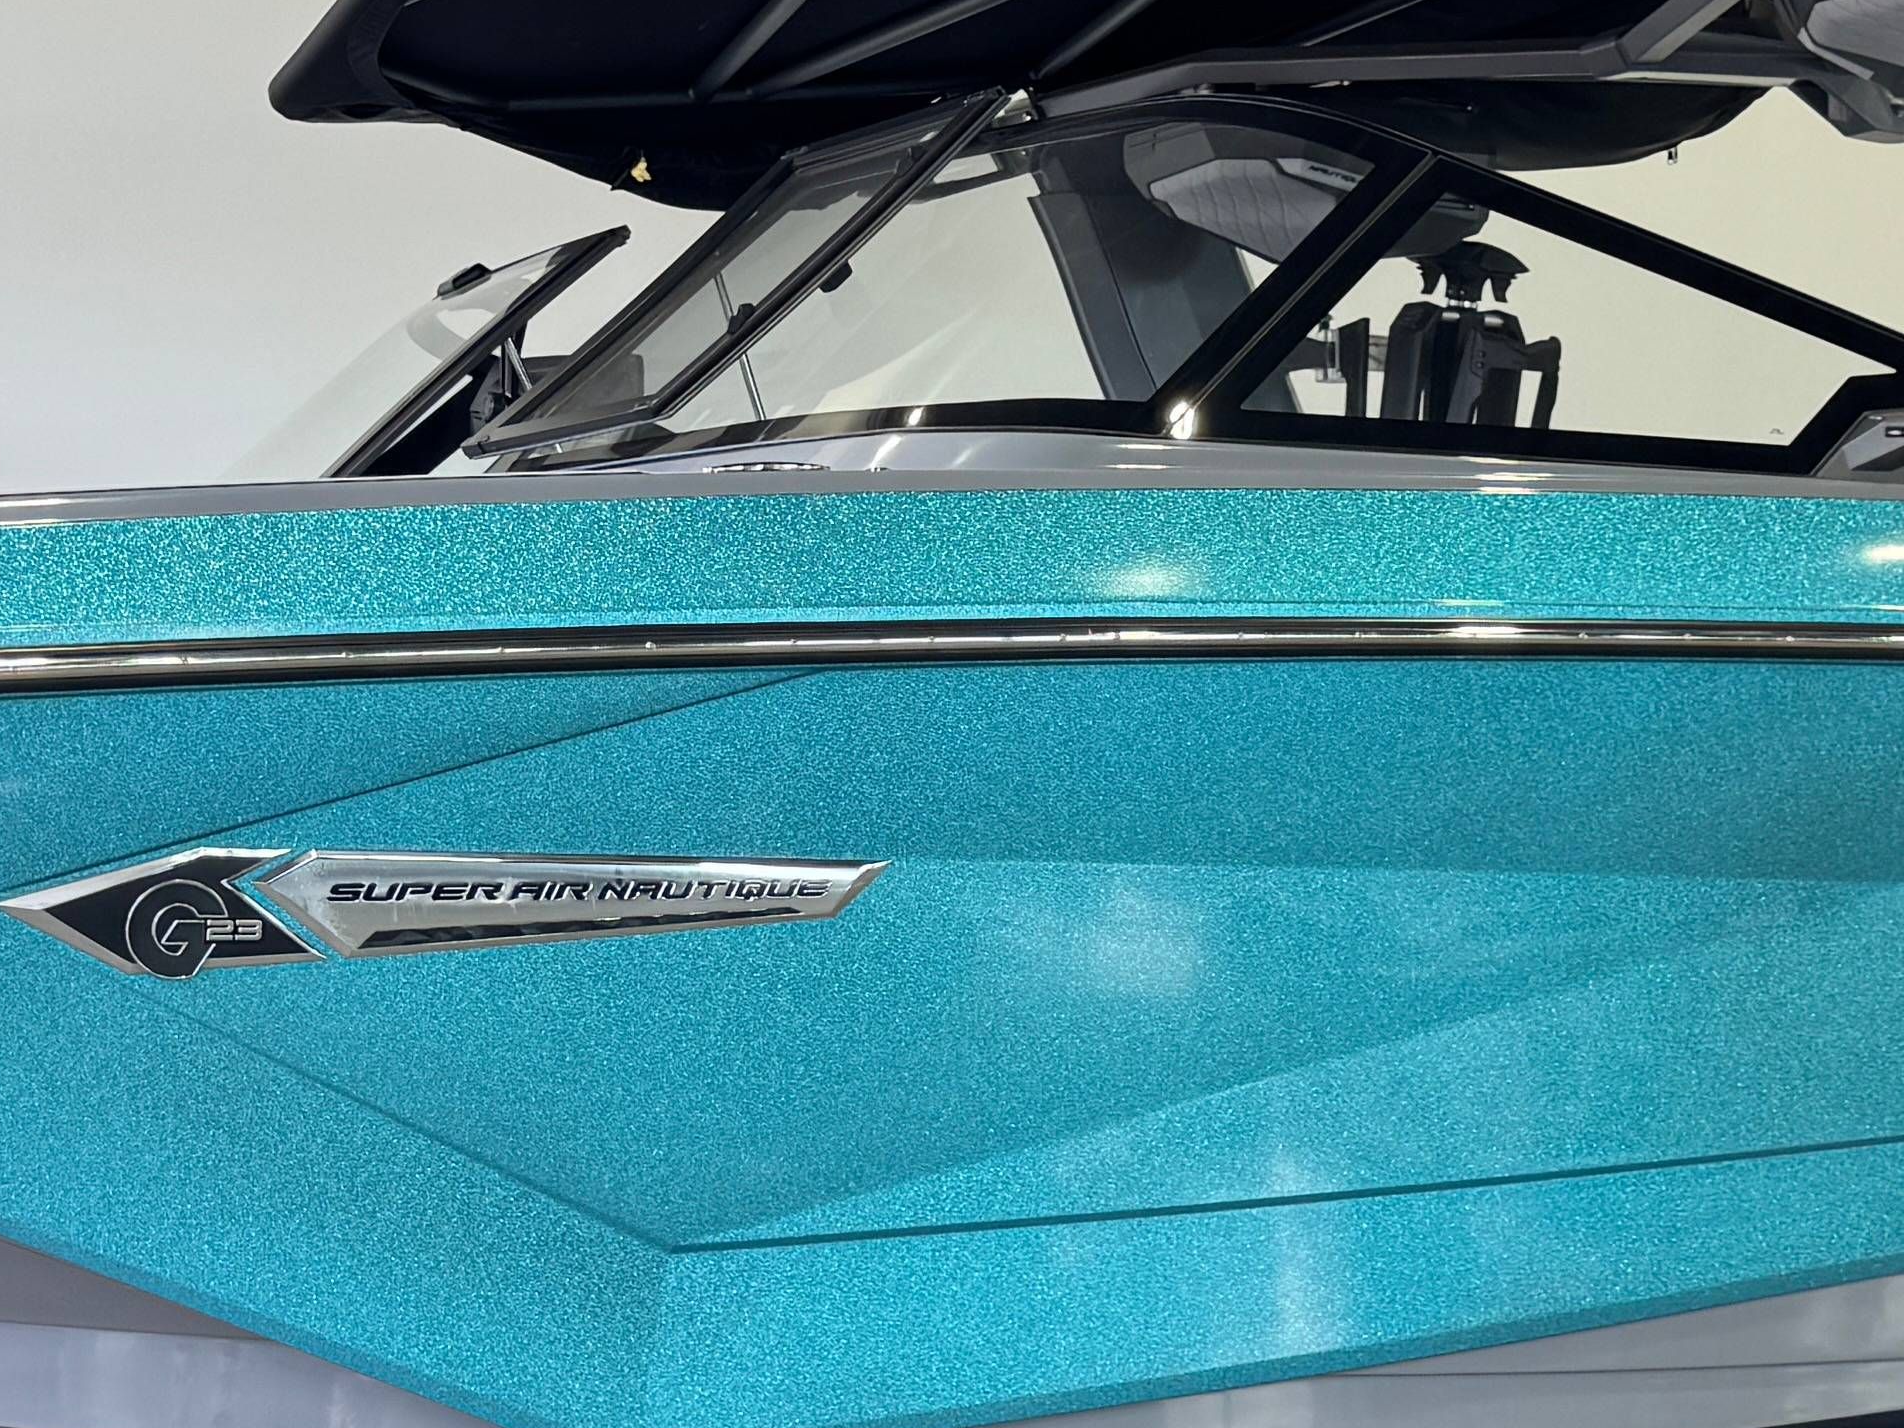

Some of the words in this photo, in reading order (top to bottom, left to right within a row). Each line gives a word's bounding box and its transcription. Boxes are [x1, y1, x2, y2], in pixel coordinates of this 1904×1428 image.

[326, 882, 512, 903] SUPER
[508, 880, 594, 902] AIR
[597, 878, 833, 902] NAUTIQUE
